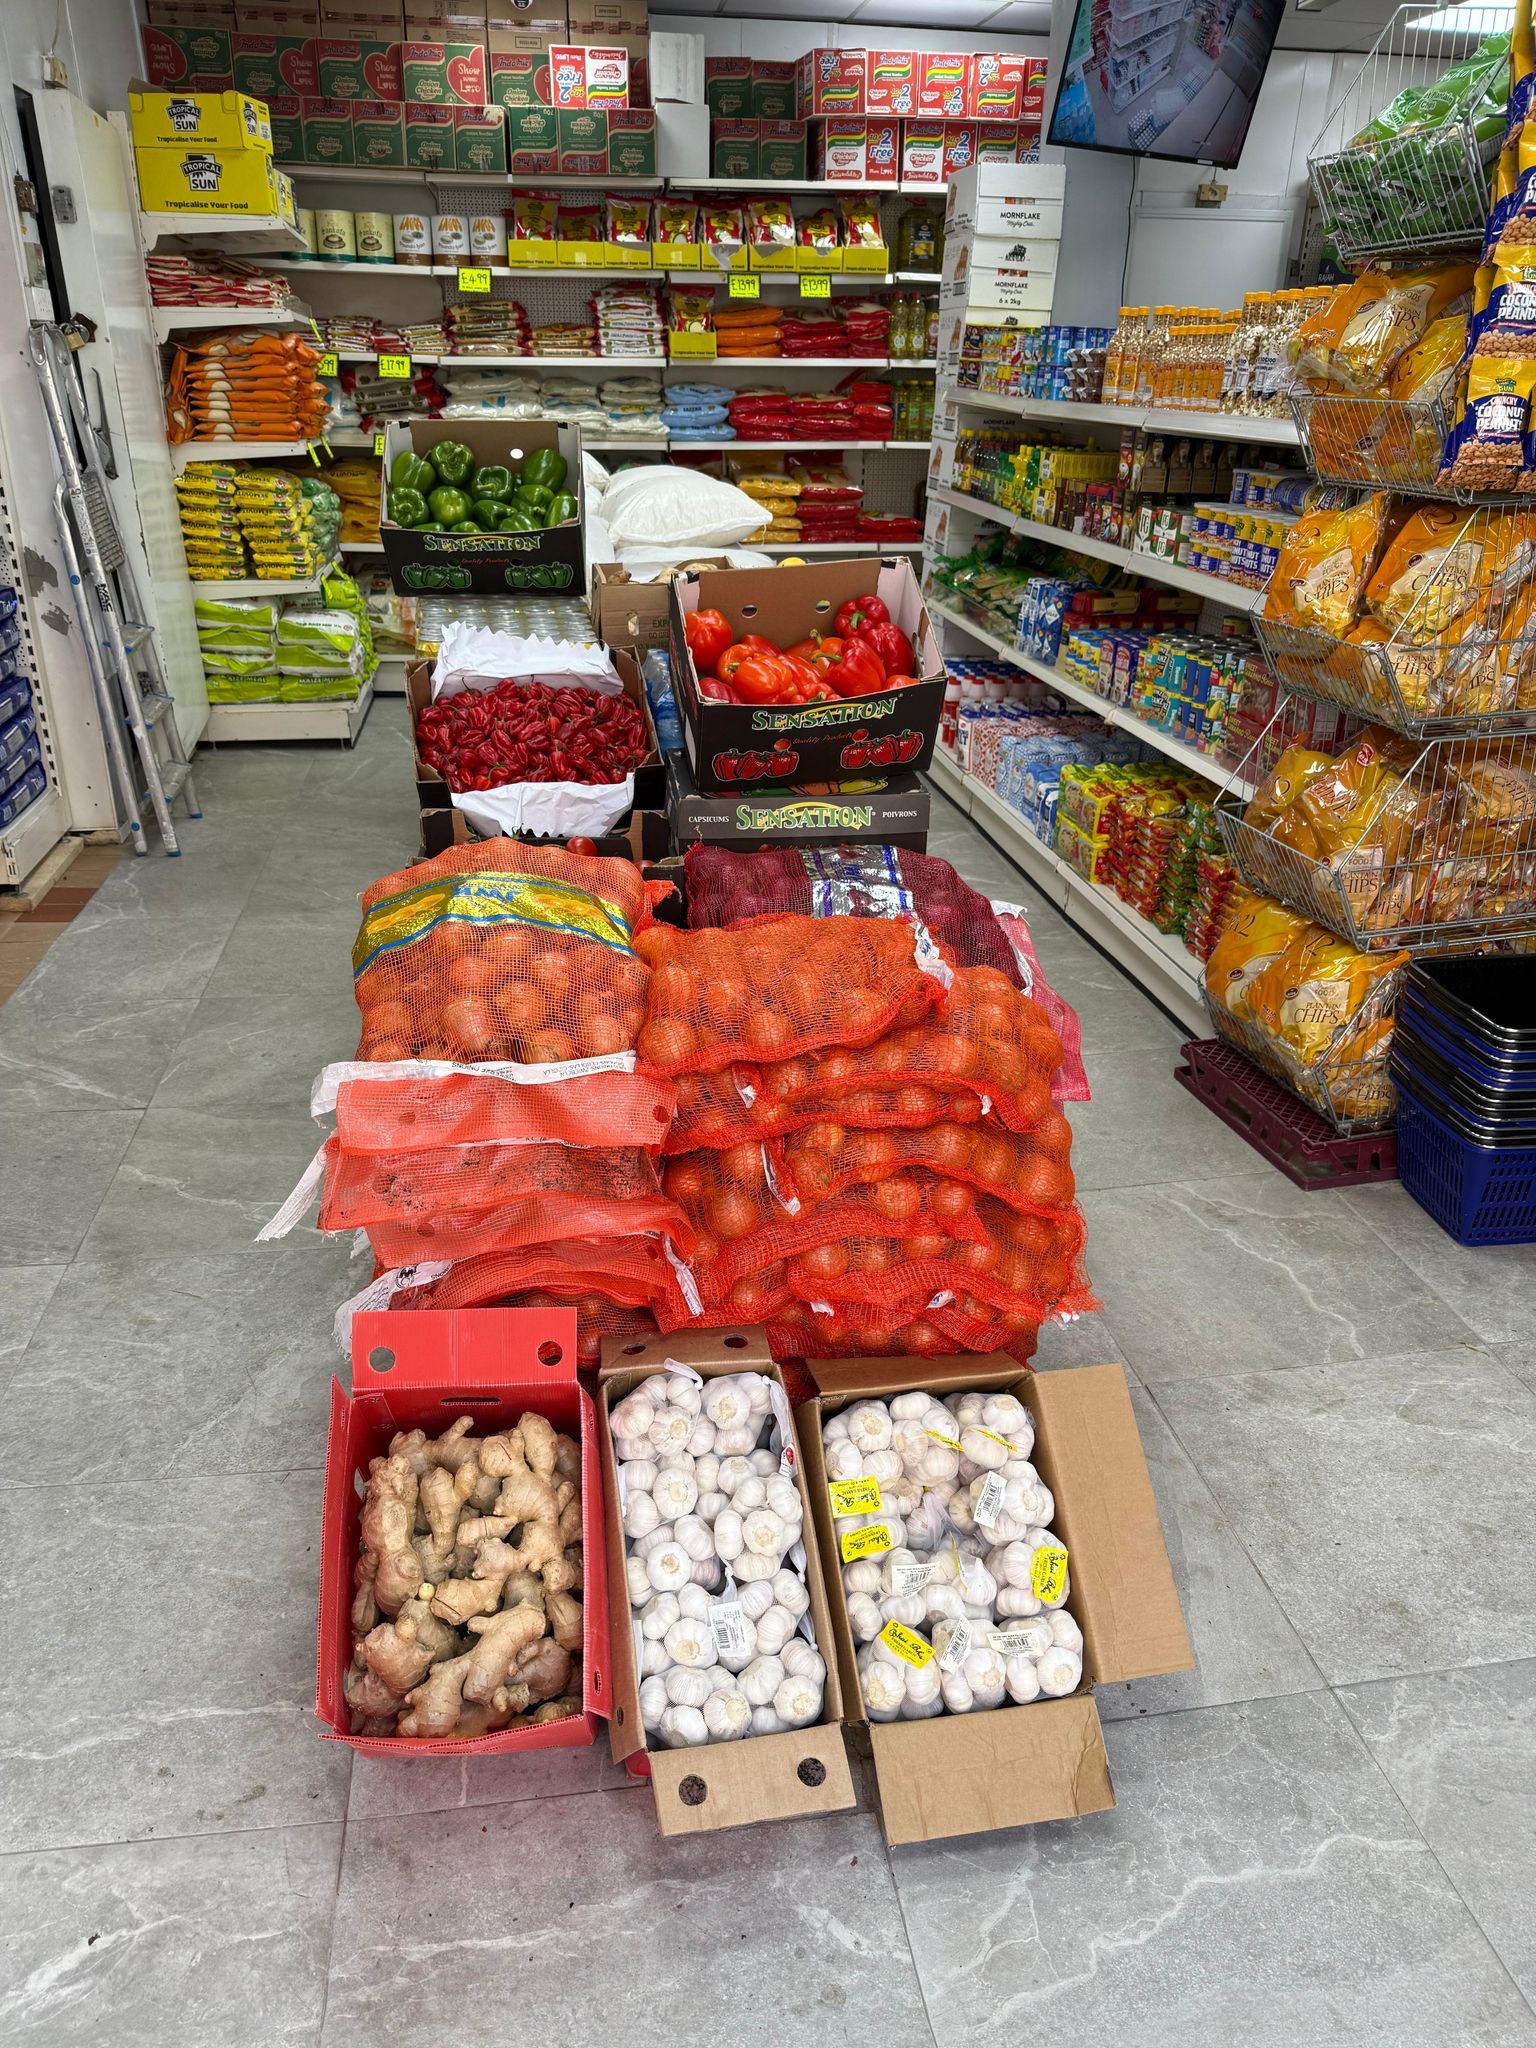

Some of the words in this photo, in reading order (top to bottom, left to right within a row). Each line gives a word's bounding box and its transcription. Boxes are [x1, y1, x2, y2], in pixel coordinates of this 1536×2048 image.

[408, 45, 442, 58] Indomie
[498, 56, 529, 68] Indomie
[820, 57, 840, 69] Free
[979, 62, 999, 73] Free
[458, 63, 481, 75] Show
[557, 70, 583, 84] Free
[901, 85, 910, 98] 2
[953, 88, 962, 100] 2
[892, 98, 911, 109] Free
[944, 101, 963, 112] Free
[168, 106, 200, 118] TROPICAL
[175, 120, 198, 131] SUN
[157, 136, 189, 144] Tropicalise
[880, 128, 893, 145] 2
[958, 132, 970, 147] 2
[1030, 134, 1041, 150] 2
[832, 151, 858, 161] Chicken
[870, 147, 893, 159] Free
[910, 153, 936, 163] Chicken
[947, 149, 970, 161] Free
[183, 160, 221, 173] TROPICAL
[192, 179, 216, 189] SUN
[165, 200, 208, 209] Tropicalise
[1000, 212, 1041, 220] MORNFLAKE
[1318, 273, 1335, 282] RAJAH
[1010, 298, 1021, 306] 2kg
[1499, 293, 1536, 307] COCON
[1499, 306, 1536, 320] PEANU
[1477, 404, 1525, 419] COCONUT
[422, 534, 542, 553] SENSATION
[1304, 581, 1349, 604] CHIPS
[652, 619, 668, 628] EXP
[752, 697, 898, 732] SENSATION
[793, 736, 820, 745] Quality
[821, 732, 853, 742] Products
[688, 815, 730, 824] CAPSICUMS
[736, 804, 873, 831] SENSATION
[882, 810, 918, 819] POIVRONS
[1329, 879, 1379, 895] CHIPS
[1305, 1002, 1341, 1010] PLANTAIN
[1295, 1007, 1340, 1025] CHIPS
